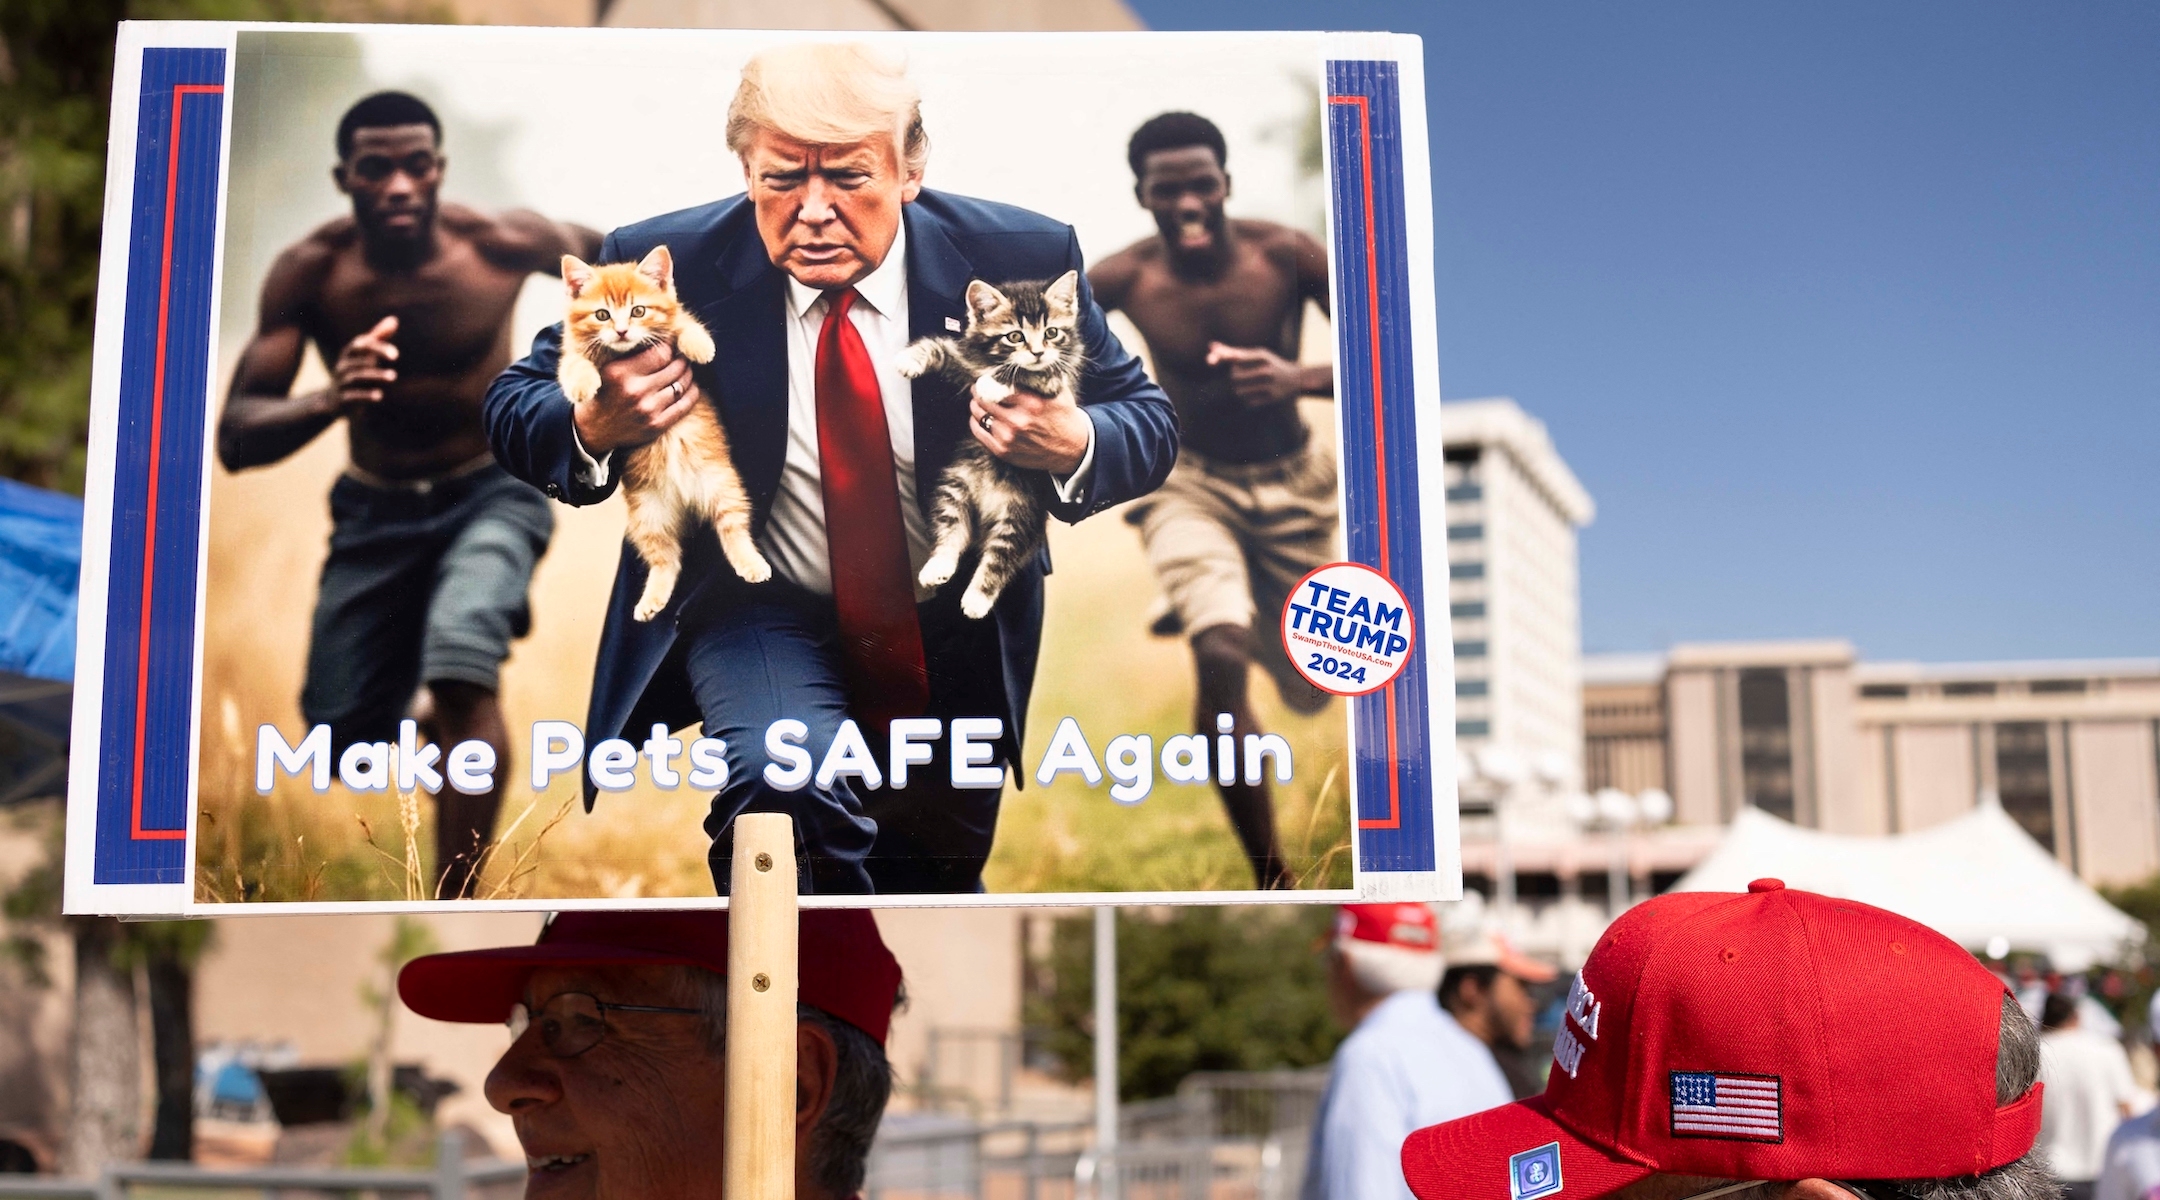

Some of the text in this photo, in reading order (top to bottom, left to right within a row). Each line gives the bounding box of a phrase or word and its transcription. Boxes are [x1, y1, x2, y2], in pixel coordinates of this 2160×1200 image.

[1290, 602, 1408, 657] TRUMP
[1308, 580, 1404, 631] TEAM
[1292, 632, 1393, 668] SwampTheVoteUSA.com
[1307, 652, 1366, 684] 2024
[255, 711, 1294, 804] Make Pets SAFE Again
